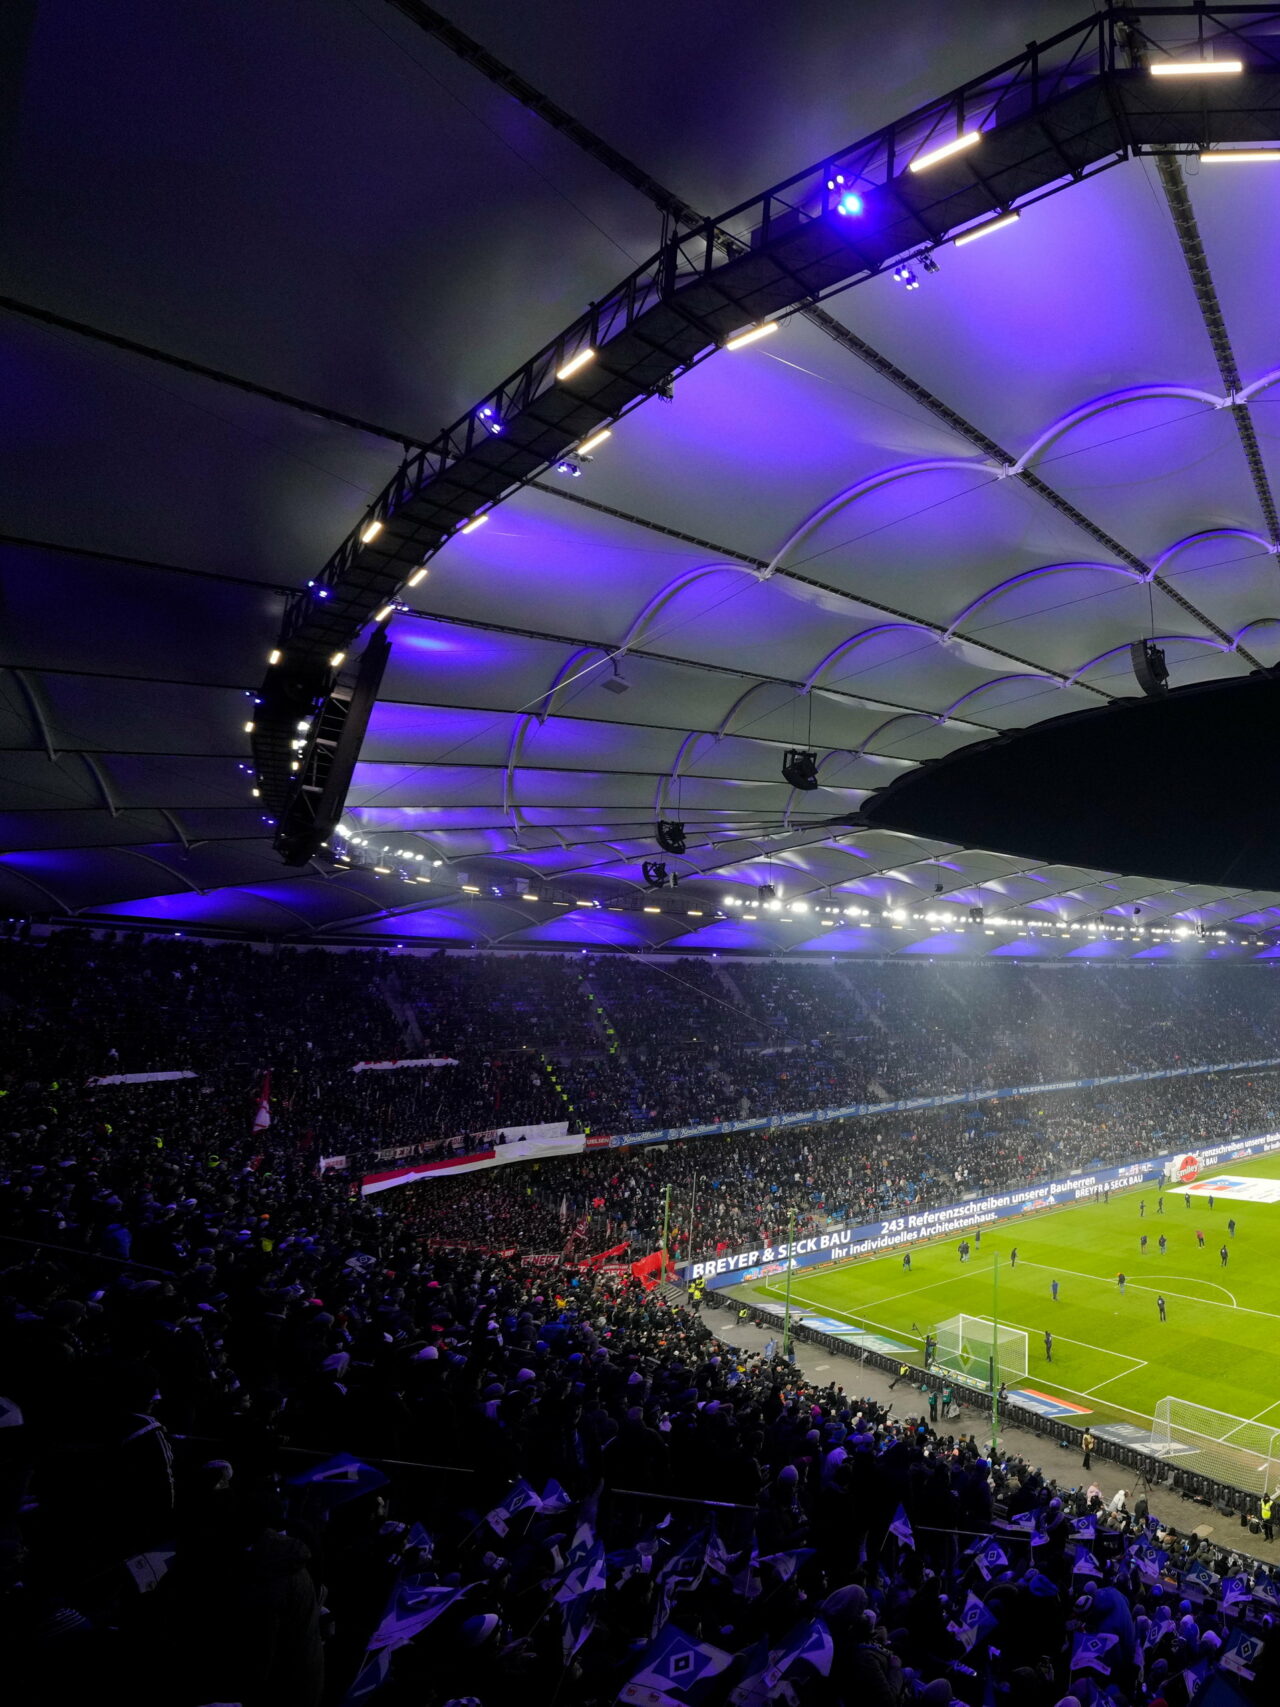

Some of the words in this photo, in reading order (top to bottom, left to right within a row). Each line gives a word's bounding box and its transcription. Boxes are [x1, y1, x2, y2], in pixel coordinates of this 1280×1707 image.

[880, 1219, 905, 1235] 243
[908, 1196, 1010, 1228] Referenzschreiben
[1013, 1187, 1049, 1203] unserer
[1050, 1176, 1096, 1195] Bauherren
[1075, 1183, 1103, 1199] BREYER
[1110, 1178, 1128, 1190] SECK
[1129, 1174, 1144, 1186] BAU
[692, 1254, 760, 1279] BREYER
[762, 1247, 774, 1262] &
[778, 1237, 818, 1259] SECK
[820, 1229, 851, 1247] BAU
[831, 1245, 848, 1260] Ihr
[849, 1230, 918, 1255] individuelles
[919, 1212, 998, 1237] Architektenhaus.
